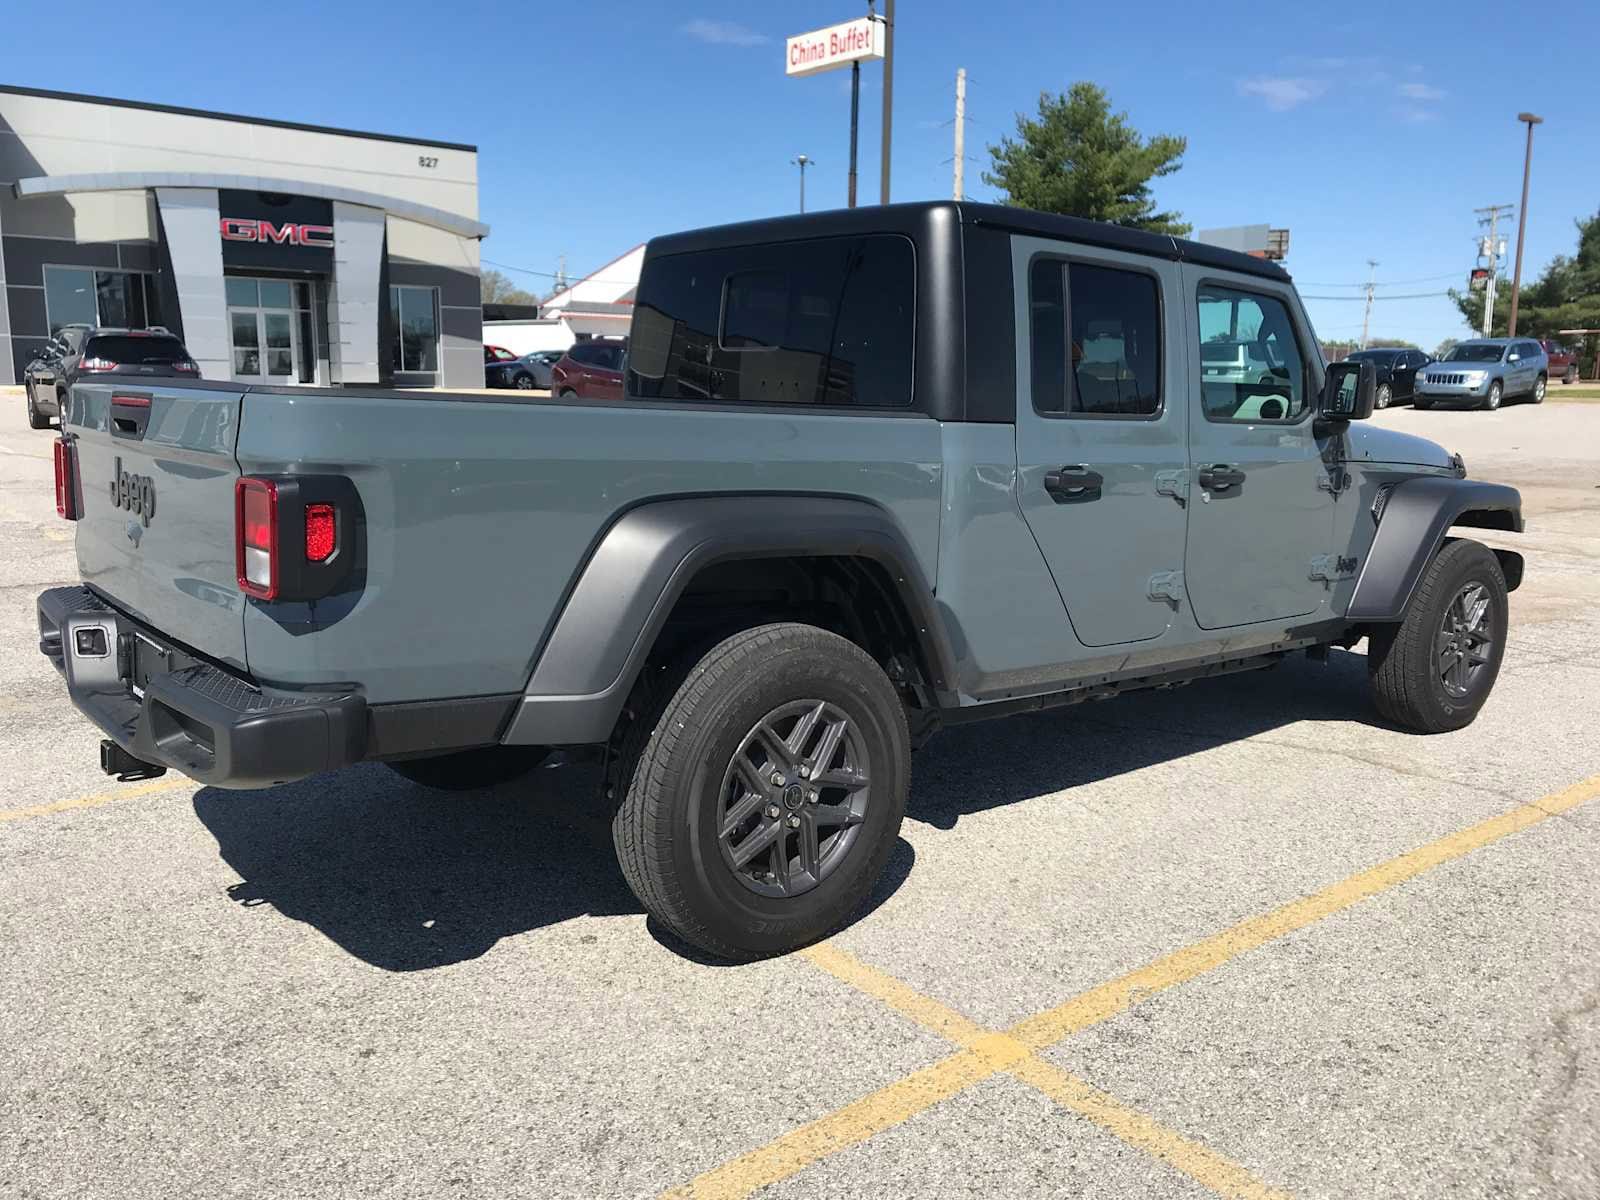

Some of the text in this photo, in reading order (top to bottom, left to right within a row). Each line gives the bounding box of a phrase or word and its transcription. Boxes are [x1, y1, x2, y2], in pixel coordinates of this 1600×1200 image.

[790, 26, 870, 66] China Buffet
[418, 156, 439, 168] 827
[220, 217, 334, 248] GMC
[109, 456, 157, 528] Jeep
